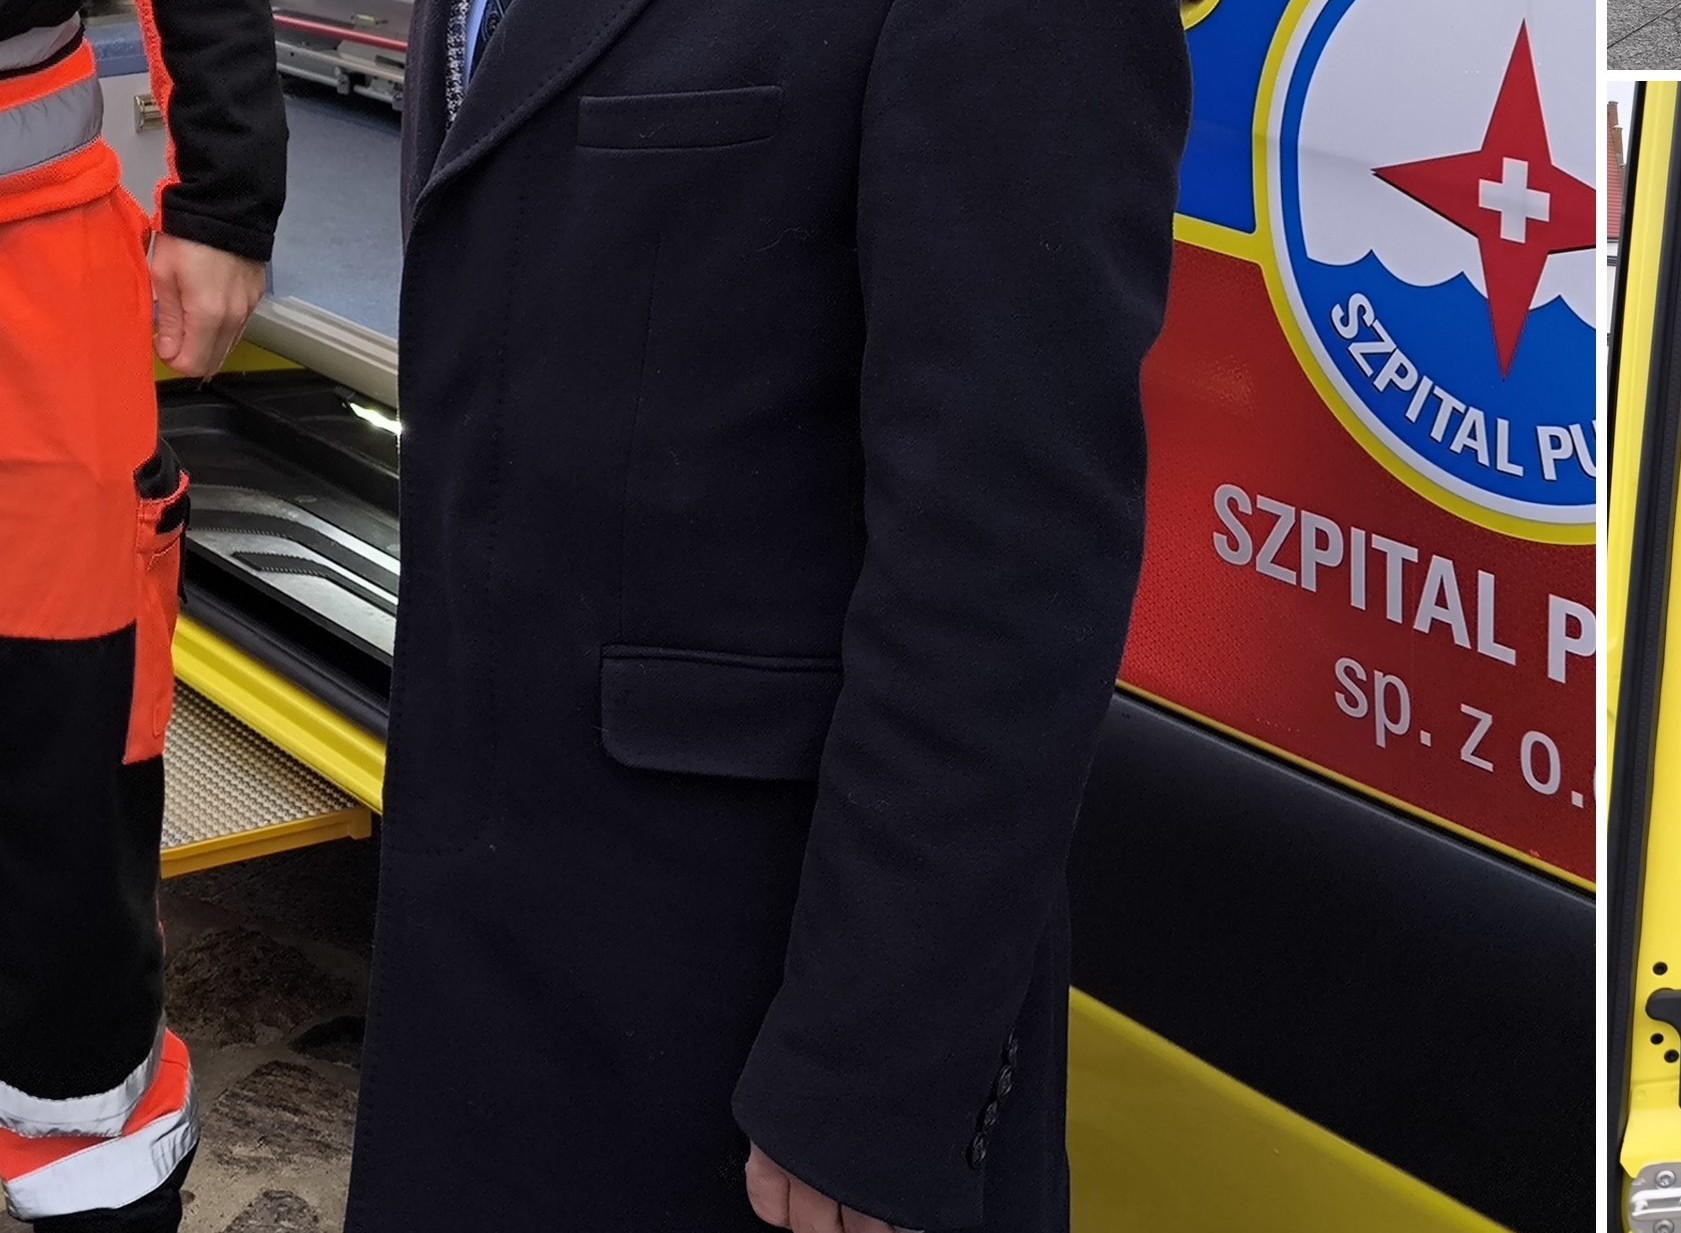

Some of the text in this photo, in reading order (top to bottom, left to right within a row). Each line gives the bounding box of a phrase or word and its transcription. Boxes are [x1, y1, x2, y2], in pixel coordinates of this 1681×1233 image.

[1331, 292, 1525, 479] SZPITAL
[1212, 483, 1596, 685] SZPITAL P
[1333, 657, 1596, 809] sp. z o.
